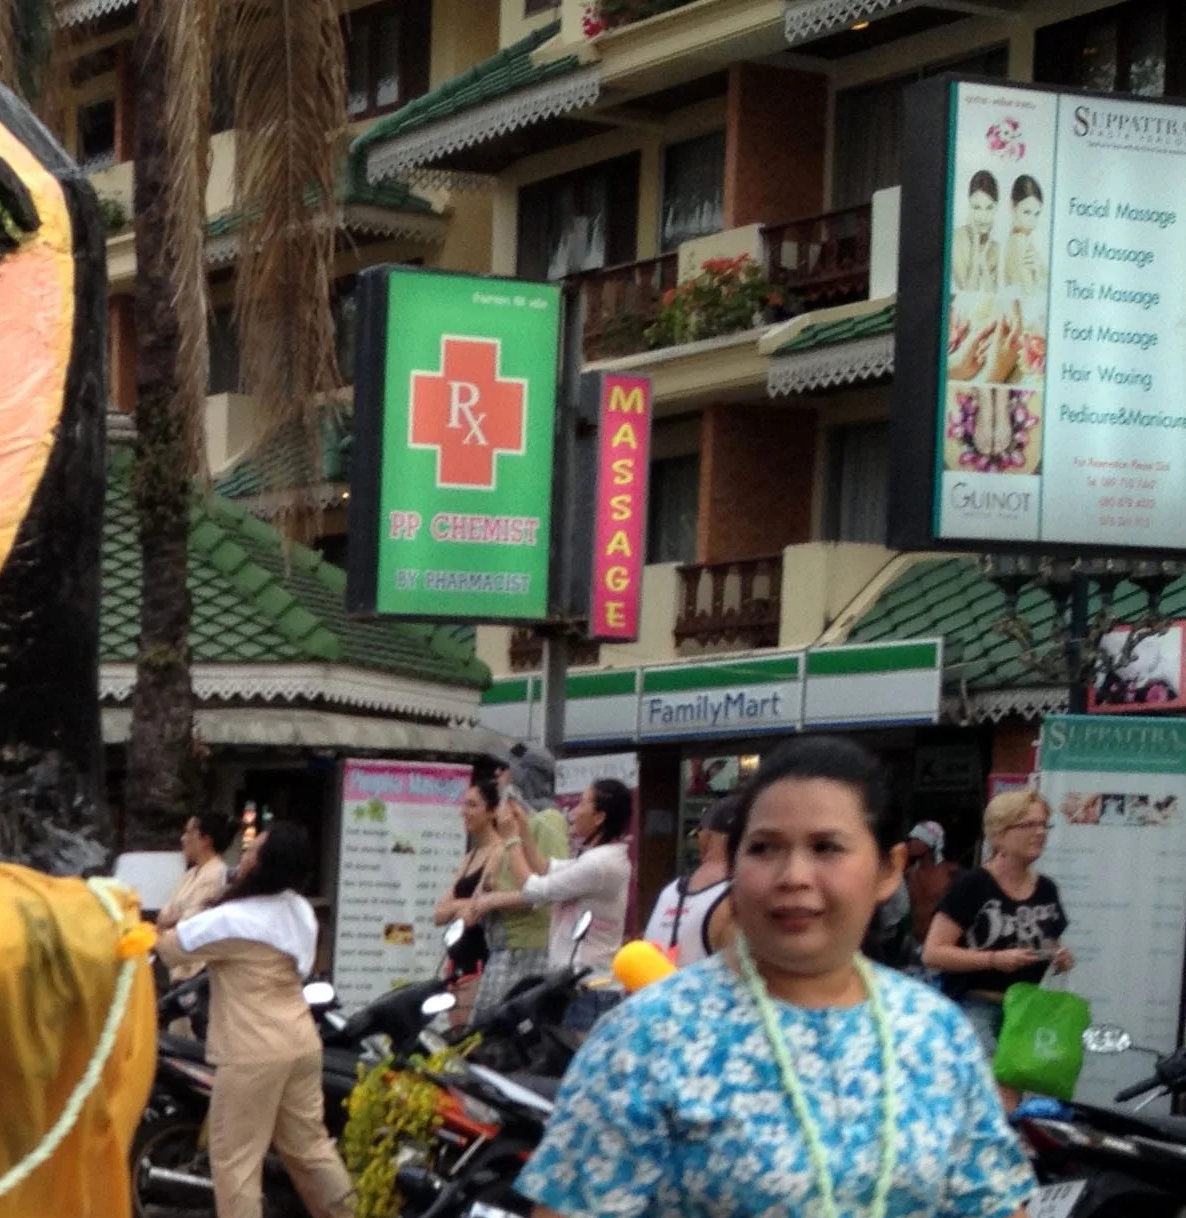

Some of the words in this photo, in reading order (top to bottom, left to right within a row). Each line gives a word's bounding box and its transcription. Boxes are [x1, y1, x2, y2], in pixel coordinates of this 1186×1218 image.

[1073, 105, 1186, 138] SUPPATTR
[1069, 196, 1111, 218] Facial
[1115, 201, 1176, 229] Massage
[1066, 238, 1089, 257] Oil
[1093, 241, 1155, 268] Massage
[1064, 278, 1094, 300] Thai
[1097, 283, 1160, 310] Massage
[1063, 320, 1092, 341] Foot
[1096, 325, 1159, 351] Massage
[1061, 361, 1091, 382] Hair
[1097, 364, 1153, 392] Waxing
[605, 386, 645, 628] MASSAGE
[950, 482, 1031, 512] GUINOT
[389, 511, 422, 540] PP
[431, 512, 540, 546] CHEMIST
[424, 570, 531, 594] PHARMACIST
[649, 691, 781, 726] FamilyMart
